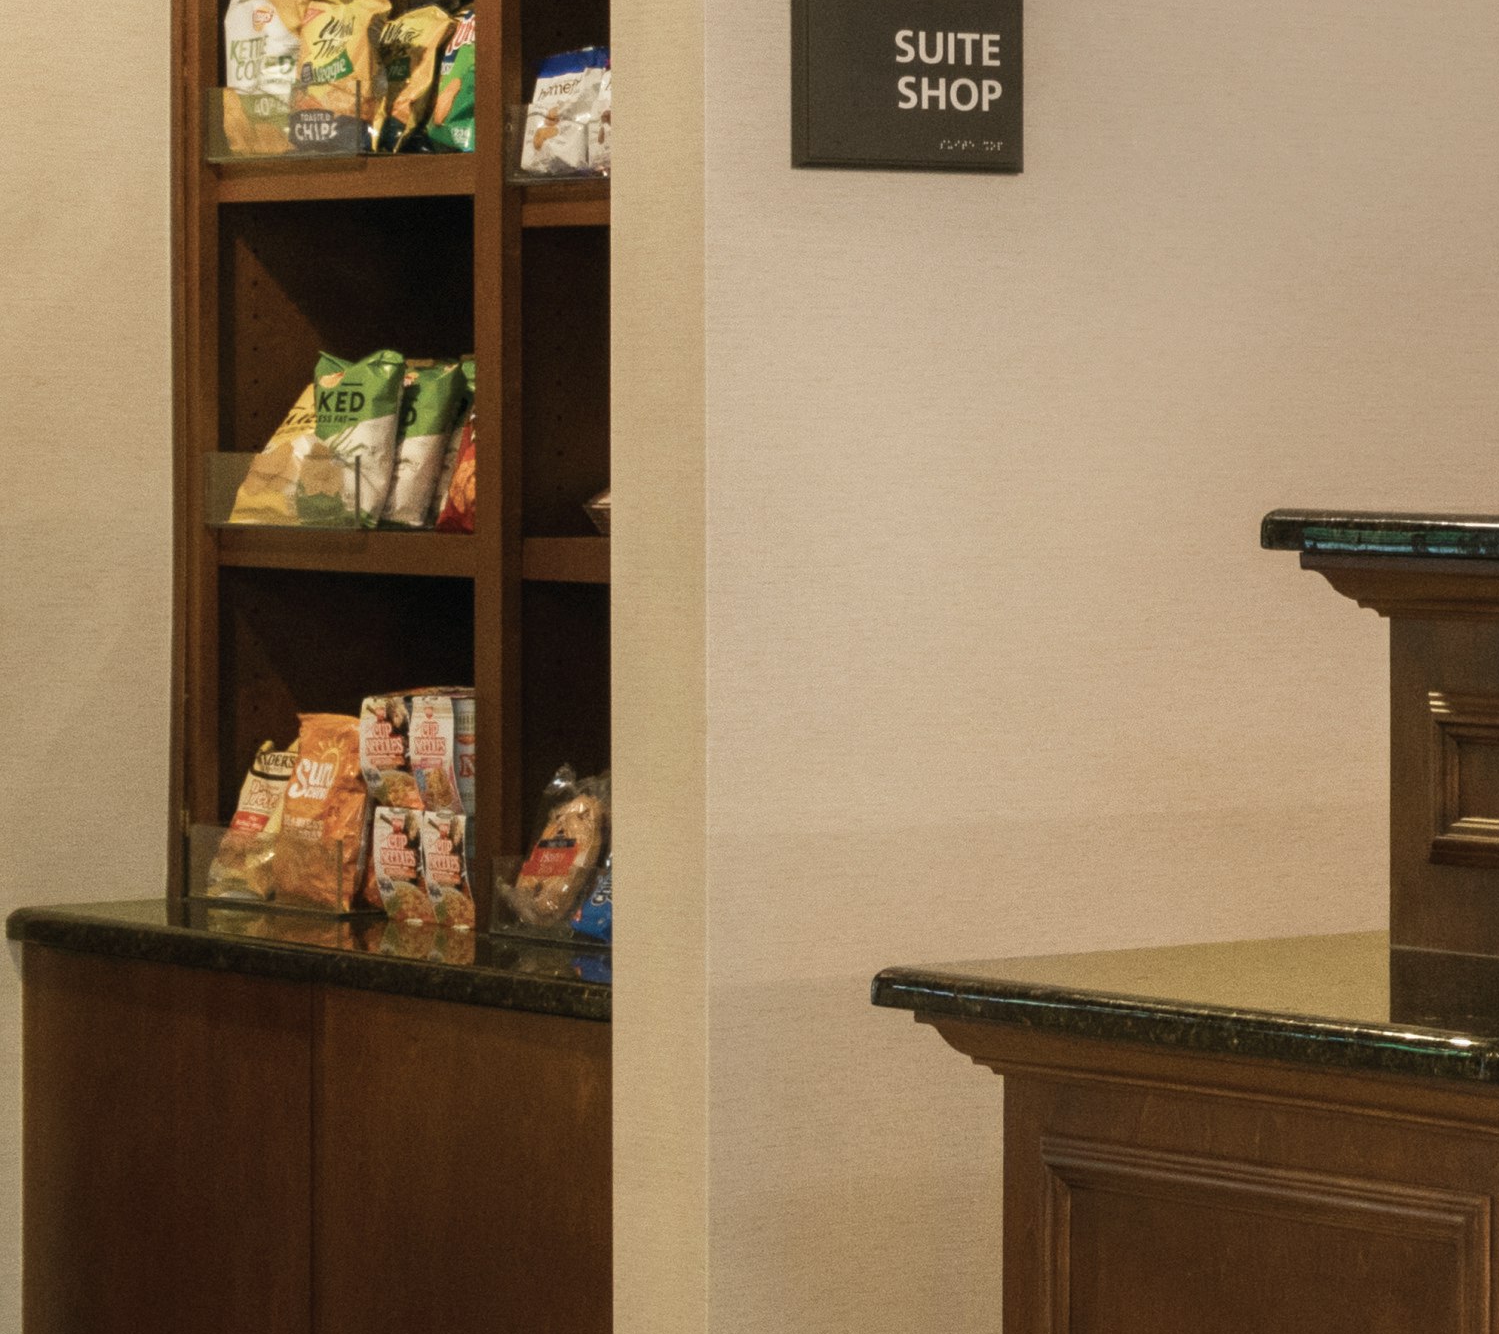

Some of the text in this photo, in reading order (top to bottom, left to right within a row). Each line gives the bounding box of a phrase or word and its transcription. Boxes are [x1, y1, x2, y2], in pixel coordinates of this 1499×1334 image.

[895, 29, 1001, 66] SUITE
[897, 76, 1003, 111] SHOP
[294, 123, 338, 142] CHIPS
[317, 391, 365, 413] KED
